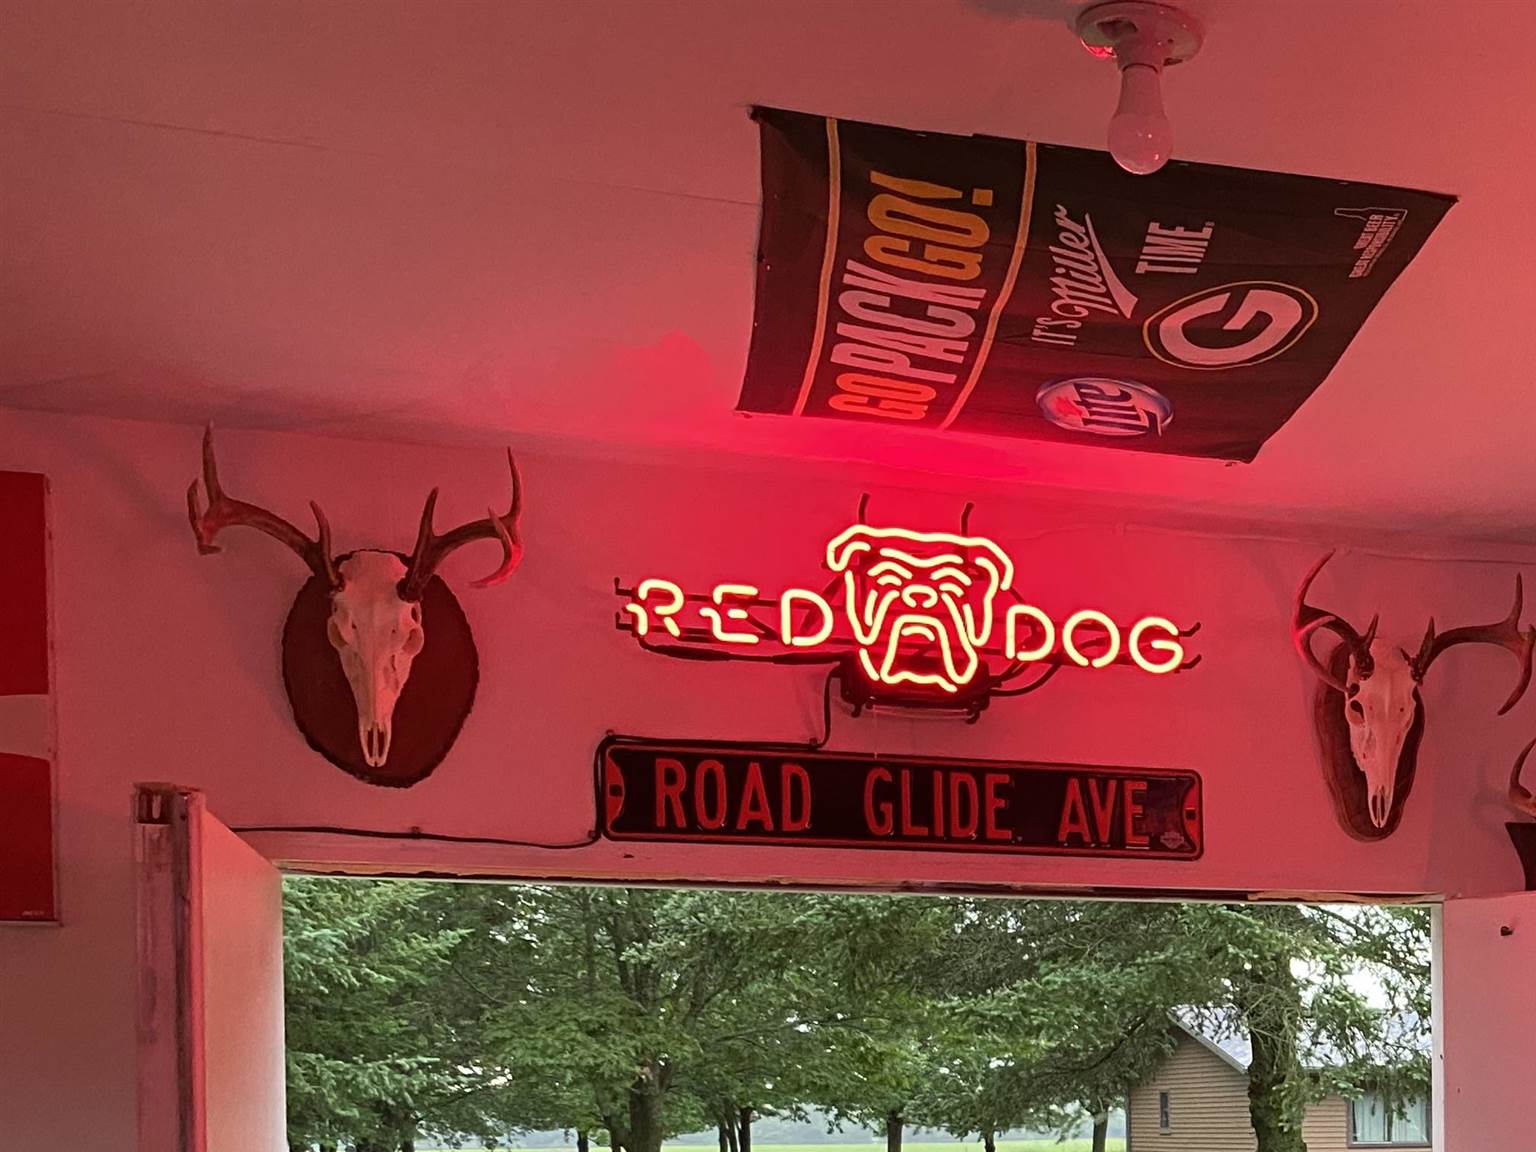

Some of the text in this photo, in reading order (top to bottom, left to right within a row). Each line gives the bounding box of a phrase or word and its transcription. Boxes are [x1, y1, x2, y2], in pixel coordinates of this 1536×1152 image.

[828, 170, 993, 420] GO PACK GO!
[1049, 203, 1132, 316] Miller
[1031, 317, 1082, 346] IT'S
[625, 578, 1185, 674] RED DOG
[653, 758, 1150, 846] ROAD GLIDE AVE
